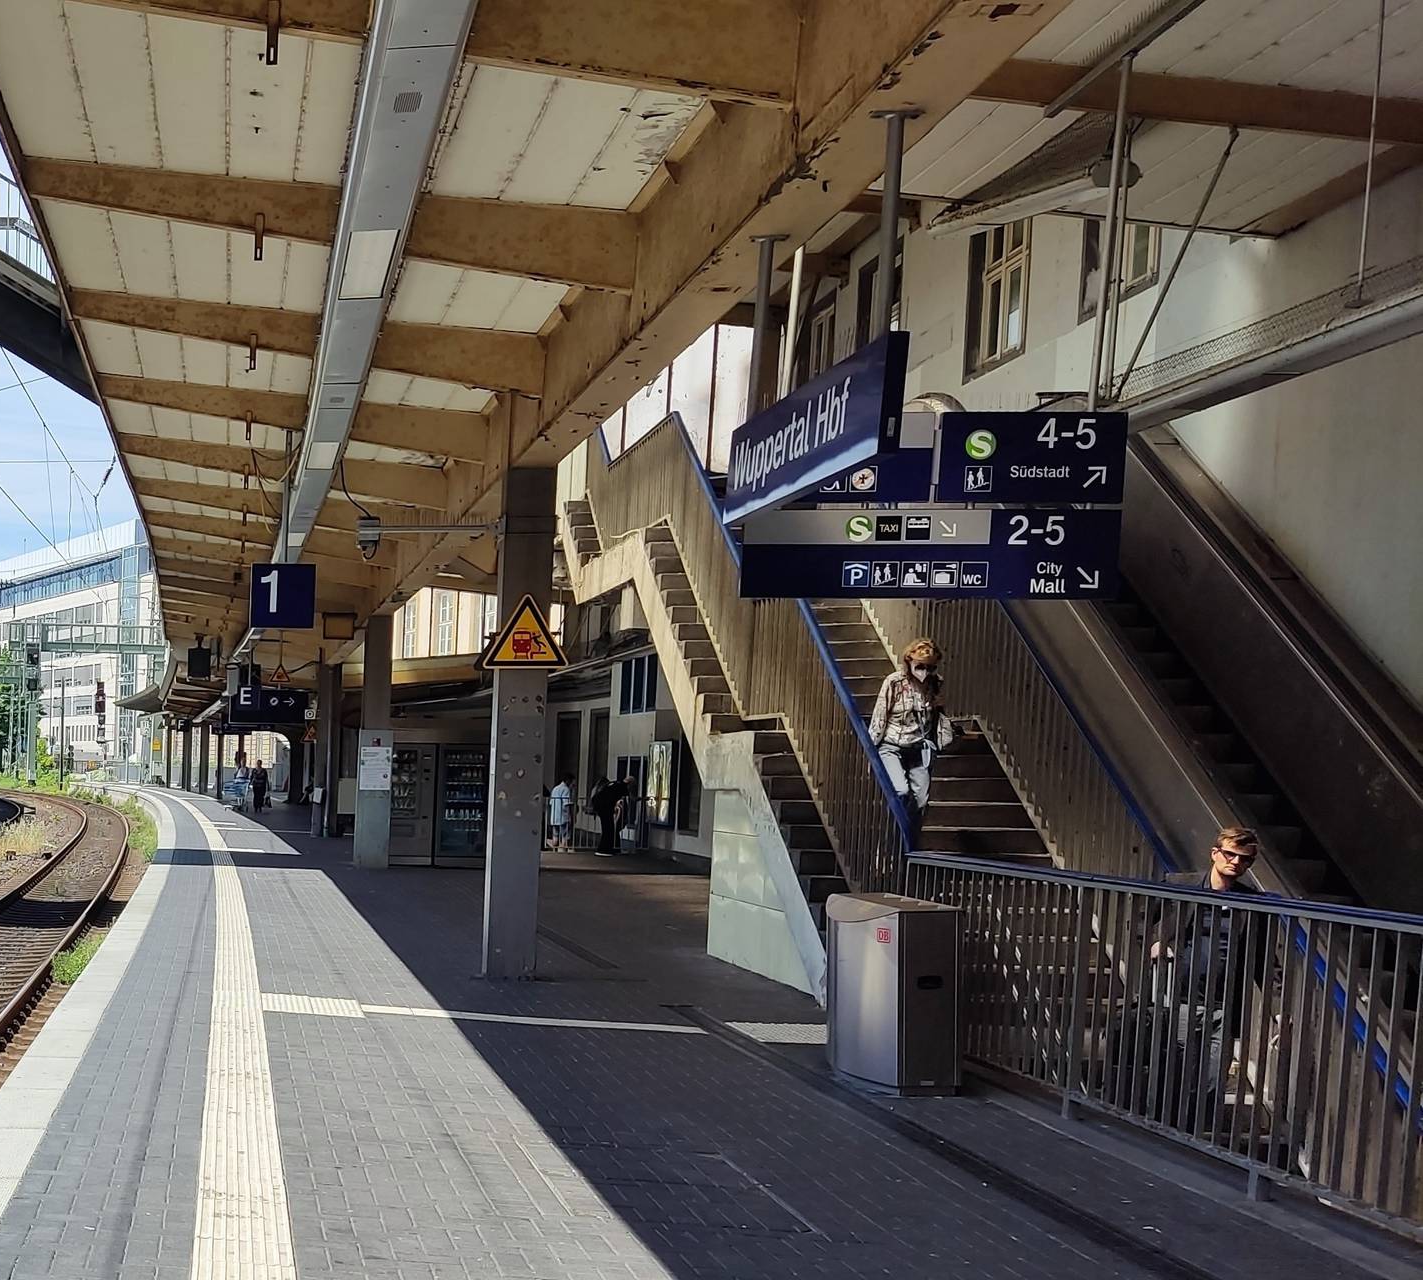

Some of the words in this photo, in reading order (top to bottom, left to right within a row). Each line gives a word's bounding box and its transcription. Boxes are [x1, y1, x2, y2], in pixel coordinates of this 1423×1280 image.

[733, 400, 812, 492] Wuppertal
[814, 376, 851, 449] Hbf
[1037, 417, 1097, 450] 4-5
[1009, 464, 1071, 479] Südstadt
[879, 523, 900, 534] TAXI
[1007, 514, 1066, 546] 2-5
[850, 568, 864, 586] P
[962, 573, 983, 586] WC
[1036, 561, 1064, 577] City
[260, 569, 279, 613] 1
[1029, 578, 1066, 594] Mall
[239, 686, 253, 705] E
[177, 719, 185, 731] F
[878, 929, 890, 942] DB
